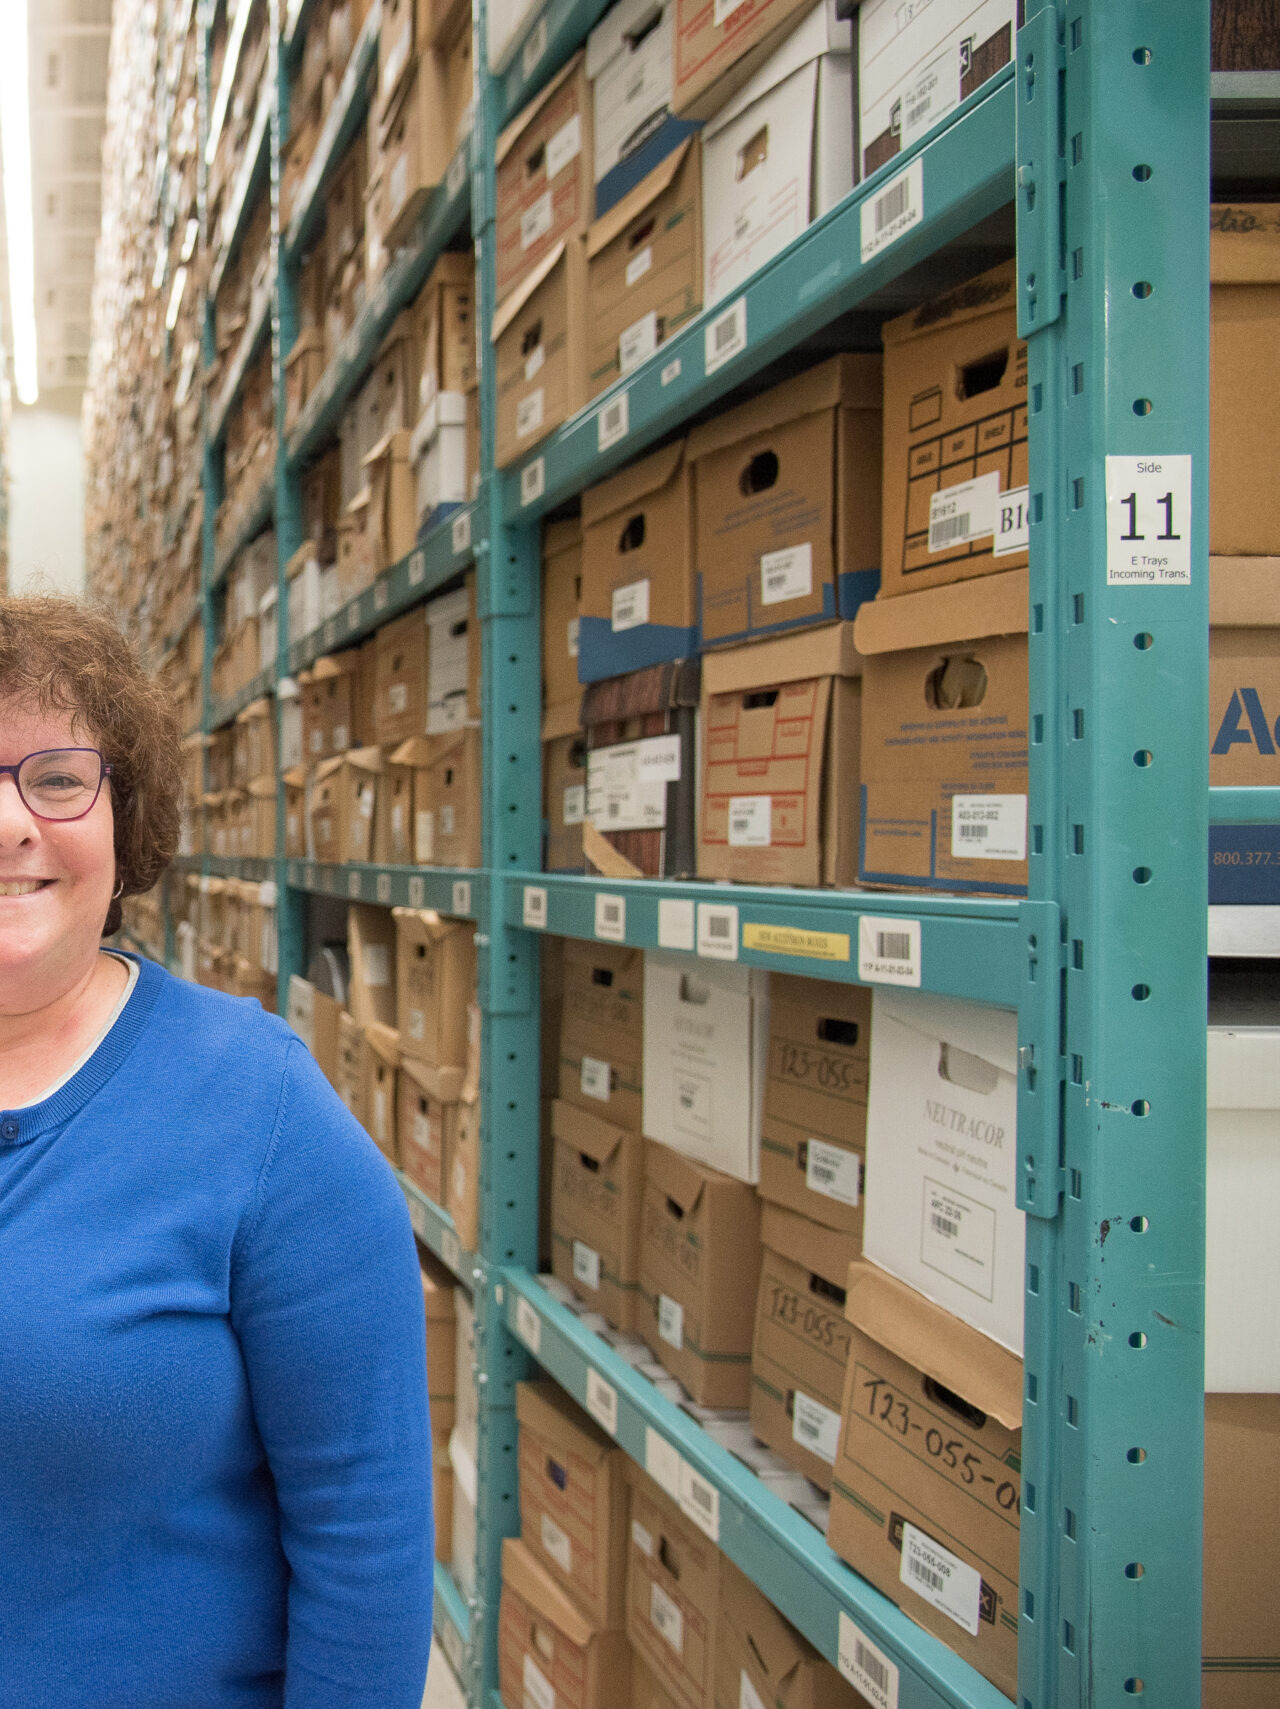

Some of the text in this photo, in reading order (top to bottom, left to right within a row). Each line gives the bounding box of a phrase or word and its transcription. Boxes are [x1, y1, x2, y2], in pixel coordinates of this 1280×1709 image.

[1136, 462, 1162, 474] Side
[1120, 492, 1181, 540] 11
[1109, 569, 1189, 580] Incoming Trans.
[1131, 555, 1169, 567] E Trays
[1210, 687, 1280, 756] A
[923, 1098, 1005, 1149] NEUTRACOR
[864, 1378, 1020, 1516] T23-055-0
[908, 1540, 951, 1578] T23-055-008
